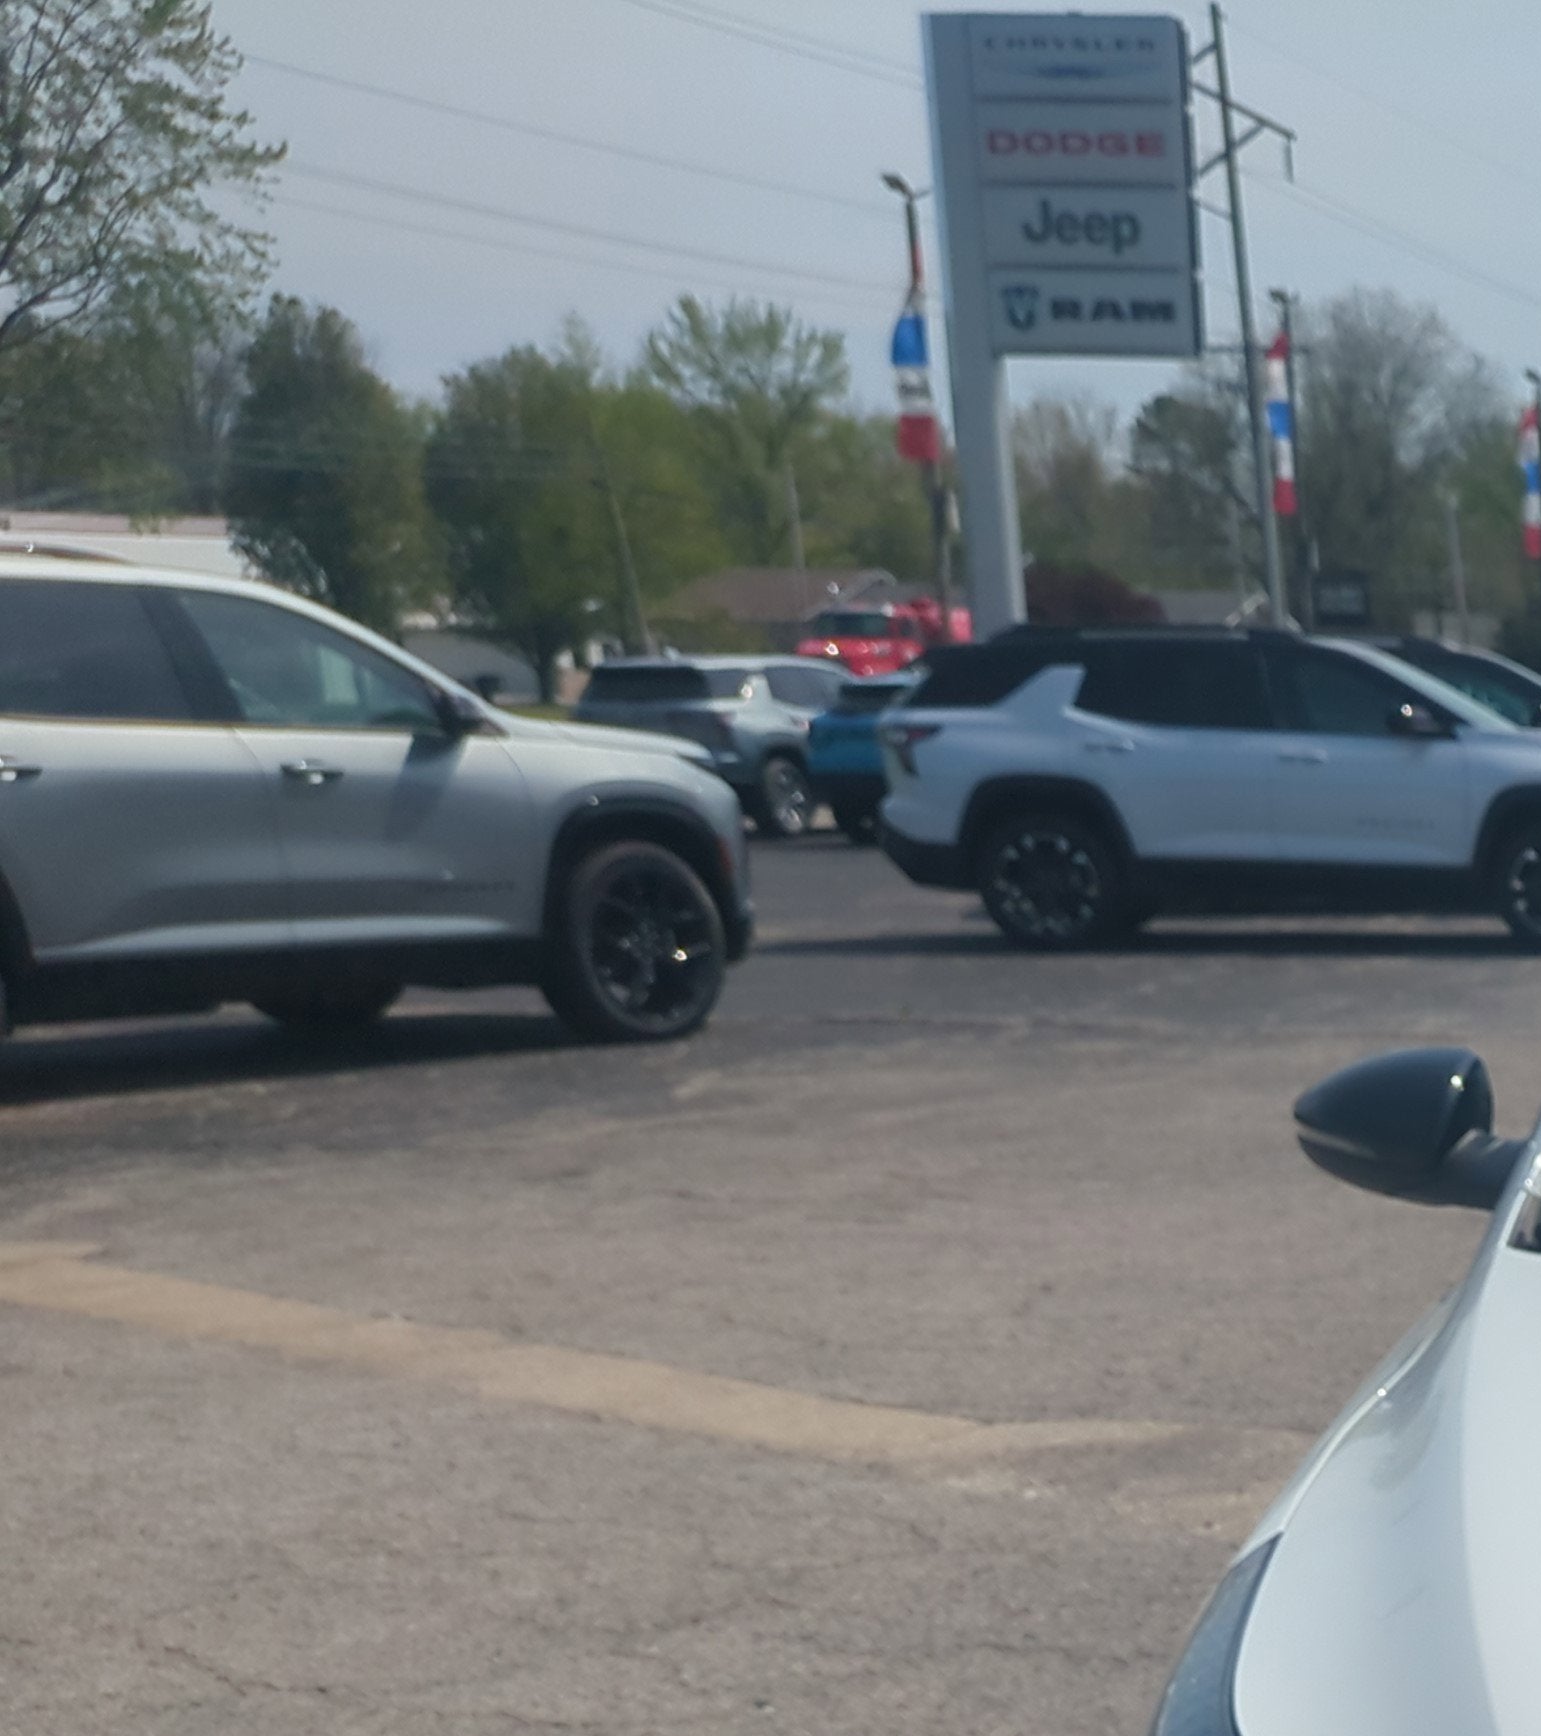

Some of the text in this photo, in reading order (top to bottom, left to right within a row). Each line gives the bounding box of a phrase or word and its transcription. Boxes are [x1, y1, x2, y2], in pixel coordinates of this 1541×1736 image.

[986, 130, 1165, 156] DODGE
[1021, 198, 1142, 254] Jeep
[1050, 299, 1176, 323] RAM
